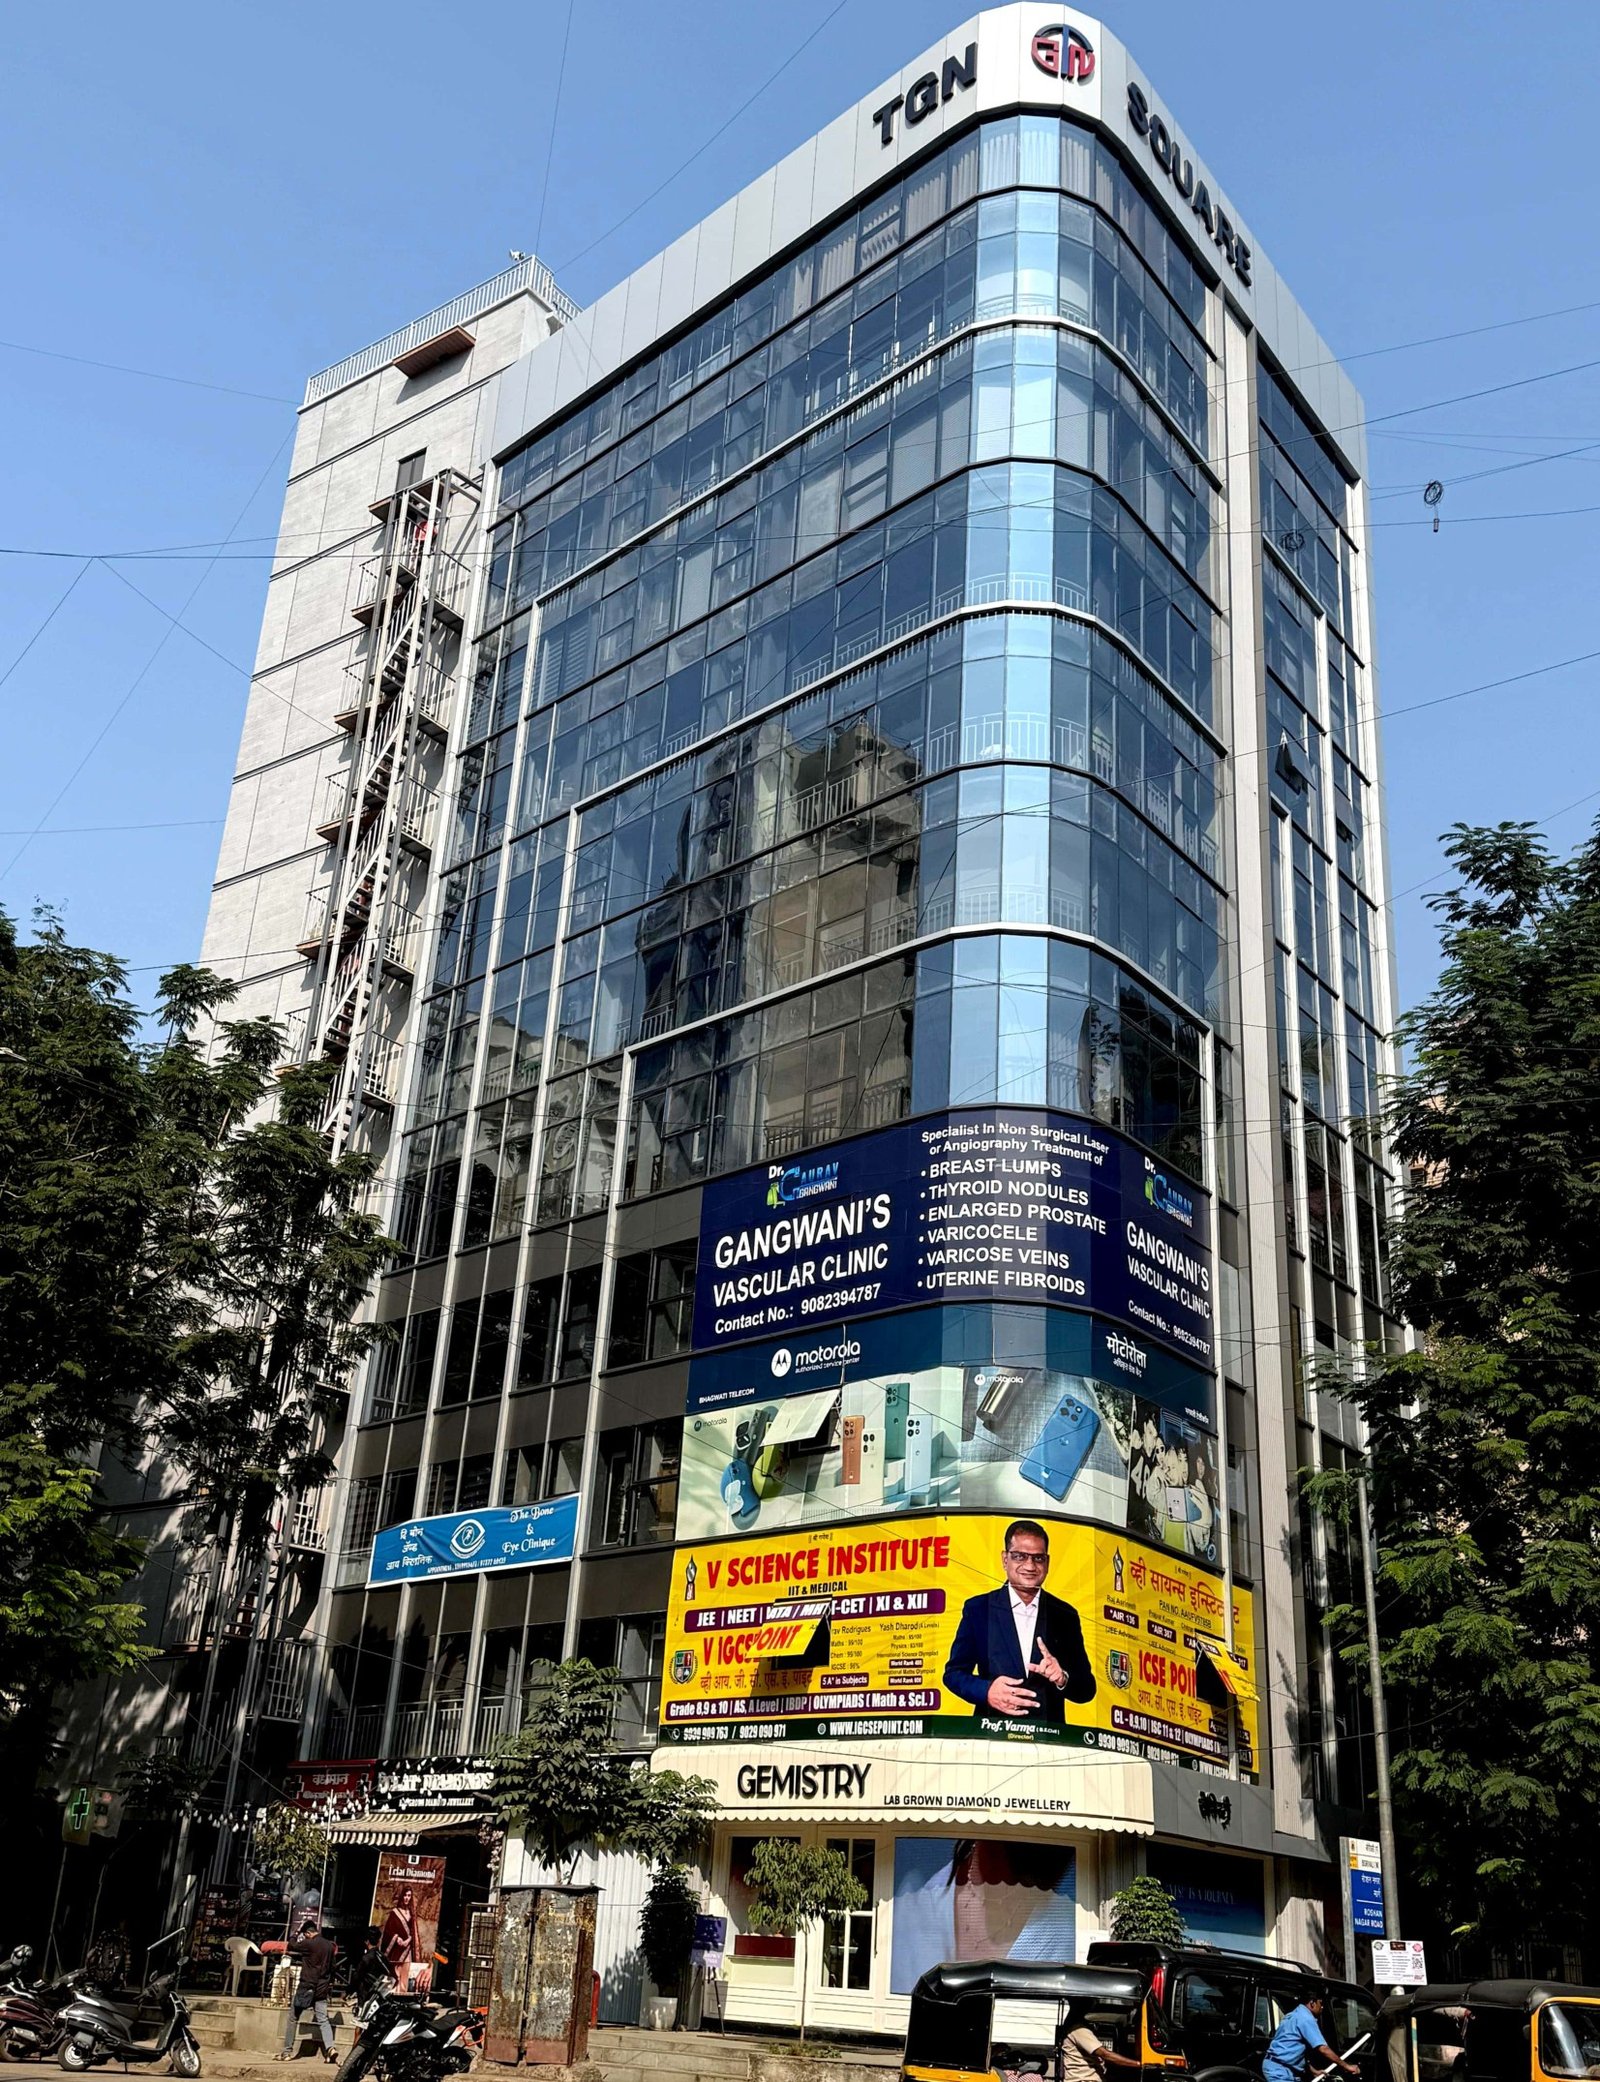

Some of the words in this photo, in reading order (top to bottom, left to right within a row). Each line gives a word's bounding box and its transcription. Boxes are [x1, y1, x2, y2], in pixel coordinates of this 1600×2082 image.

[873, 42, 977, 146] TGN
[1127, 81, 1252, 288] SQUARE
[921, 1124, 980, 1144] Specialist
[983, 1123, 995, 1134] In
[999, 1123, 1026, 1135] Non
[1030, 1124, 1081, 1144] Surgical
[1084, 1135, 1109, 1155] Laser
[929, 1145, 941, 1155] or
[943, 1138, 1028, 1153] Angiography
[1032, 1139, 1093, 1162] Treatment
[1094, 1155, 1104, 1167] of
[768, 1165, 785, 1179] Dr.
[929, 1158, 997, 1179] BREAST
[1002, 1158, 1062, 1178] LUMPS
[1144, 1156, 1157, 1174] Dr.
[799, 1177, 838, 1199] GANGWANI
[928, 1179, 1003, 1200] THYROID
[1008, 1181, 1089, 1206] NODULES
[928, 1202, 1022, 1223] ENLARGED
[1027, 1205, 1107, 1236] PROSTATE
[714, 1193, 891, 1269] GANGWANI'S
[927, 1224, 1038, 1244] VARICOCELE
[926, 1246, 1013, 1267] VARICOSE
[1018, 1248, 1070, 1269] VEINS
[1126, 1221, 1210, 1292] GANGWANI'S
[713, 1260, 816, 1307] VASCULAR
[821, 1243, 889, 1281] CLINIC
[926, 1270, 999, 1290] UTERINE
[1004, 1271, 1086, 1296] FIBROIDS
[1127, 1254, 1179, 1302] VASCULAR
[1180, 1287, 1211, 1320] CLINIC
[714, 1312, 765, 1334] Contact
[800, 1283, 882, 1315] 9082394787
[1128, 1299, 1156, 1325] Contact
[795, 1340, 861, 1366] motorola
[1105, 1331, 1147, 1369] मोटोरोला
[795, 1362, 823, 1374] authorized
[986, 1375, 1024, 1384] motorola
[729, 1387, 755, 1398] TELECOM
[509, 1510, 530, 1523] The
[530, 1506, 554, 1521] Bone
[526, 1523, 534, 1535] &
[502, 1542, 520, 1556] Eye
[520, 1537, 556, 1552] Clinique
[707, 1560, 721, 1589] V
[727, 1548, 820, 1588] SCIENCE
[827, 1535, 950, 1577] INSTITUTE
[788, 1585, 799, 1596] IIT
[801, 1585, 808, 1595] &
[810, 1581, 848, 1595] MEDICAL
[1149, 1569, 1186, 1602] सायन्स
[696, 1611, 716, 1627] JEE
[727, 1608, 757, 1625] NEET
[876, 1595, 890, 1612] XI
[893, 1597, 905, 1610] &
[907, 1593, 928, 1610] XII
[841, 1625, 871, 1635] Rodrigues
[880, 1623, 894, 1631] Yash
[895, 1621, 918, 1631] Dharod
[703, 1637, 714, 1666] V
[842, 1675, 868, 1685] Subjects
[1138, 1649, 1166, 1688] ICSE
[669, 1702, 695, 1717] Grade
[696, 1702, 710, 1716] 8,9
[711, 1701, 717, 1716] &
[718, 1701, 728, 1715] 10
[733, 1700, 747, 1715] AS,
[748, 1699, 755, 1713] A
[755, 1697, 779, 1713] Level
[786, 1695, 807, 1711] IBDP
[813, 1692, 864, 1711] OLYMPIADS
[899, 1692, 906, 1706] &
[702, 1726, 716, 1741] 909
[716, 1725, 728, 1739] 763
[739, 1725, 757, 1739] 9029
[759, 1724, 773, 1738] 090
[773, 1723, 786, 1738] 971
[829, 1719, 923, 1736] WWW.IGCSEPOINT.COM
[981, 1718, 1003, 1732] Prof.
[1004, 1719, 1036, 1735] Varma
[1008, 1733, 1034, 1741] (Director)
[1113, 1709, 1124, 1725] CL
[1150, 1718, 1161, 1736] ISC
[1162, 1722, 1169, 1738] 11
[1169, 1728, 1174, 1740] &
[1174, 1725, 1182, 1742] 12
[1184, 1731, 1214, 1752] OLYMPIADS
[1098, 1733, 1115, 1751] 9930
[1117, 1737, 1130, 1754] 909
[1129, 1740, 1139, 1756] 763
[736, 1763, 872, 1800] GEMISTRY
[884, 1794, 900, 1806] LAB
[903, 1795, 943, 1806] GROWN
[946, 1796, 1001, 1808] DIAMOND
[1005, 1798, 1071, 1811] JEWELLERY
[1354, 1918, 1371, 1927] NAGAR
[1371, 1920, 1383, 1929] ROAD
[1363, 1908, 1382, 1918] ROSHAN
